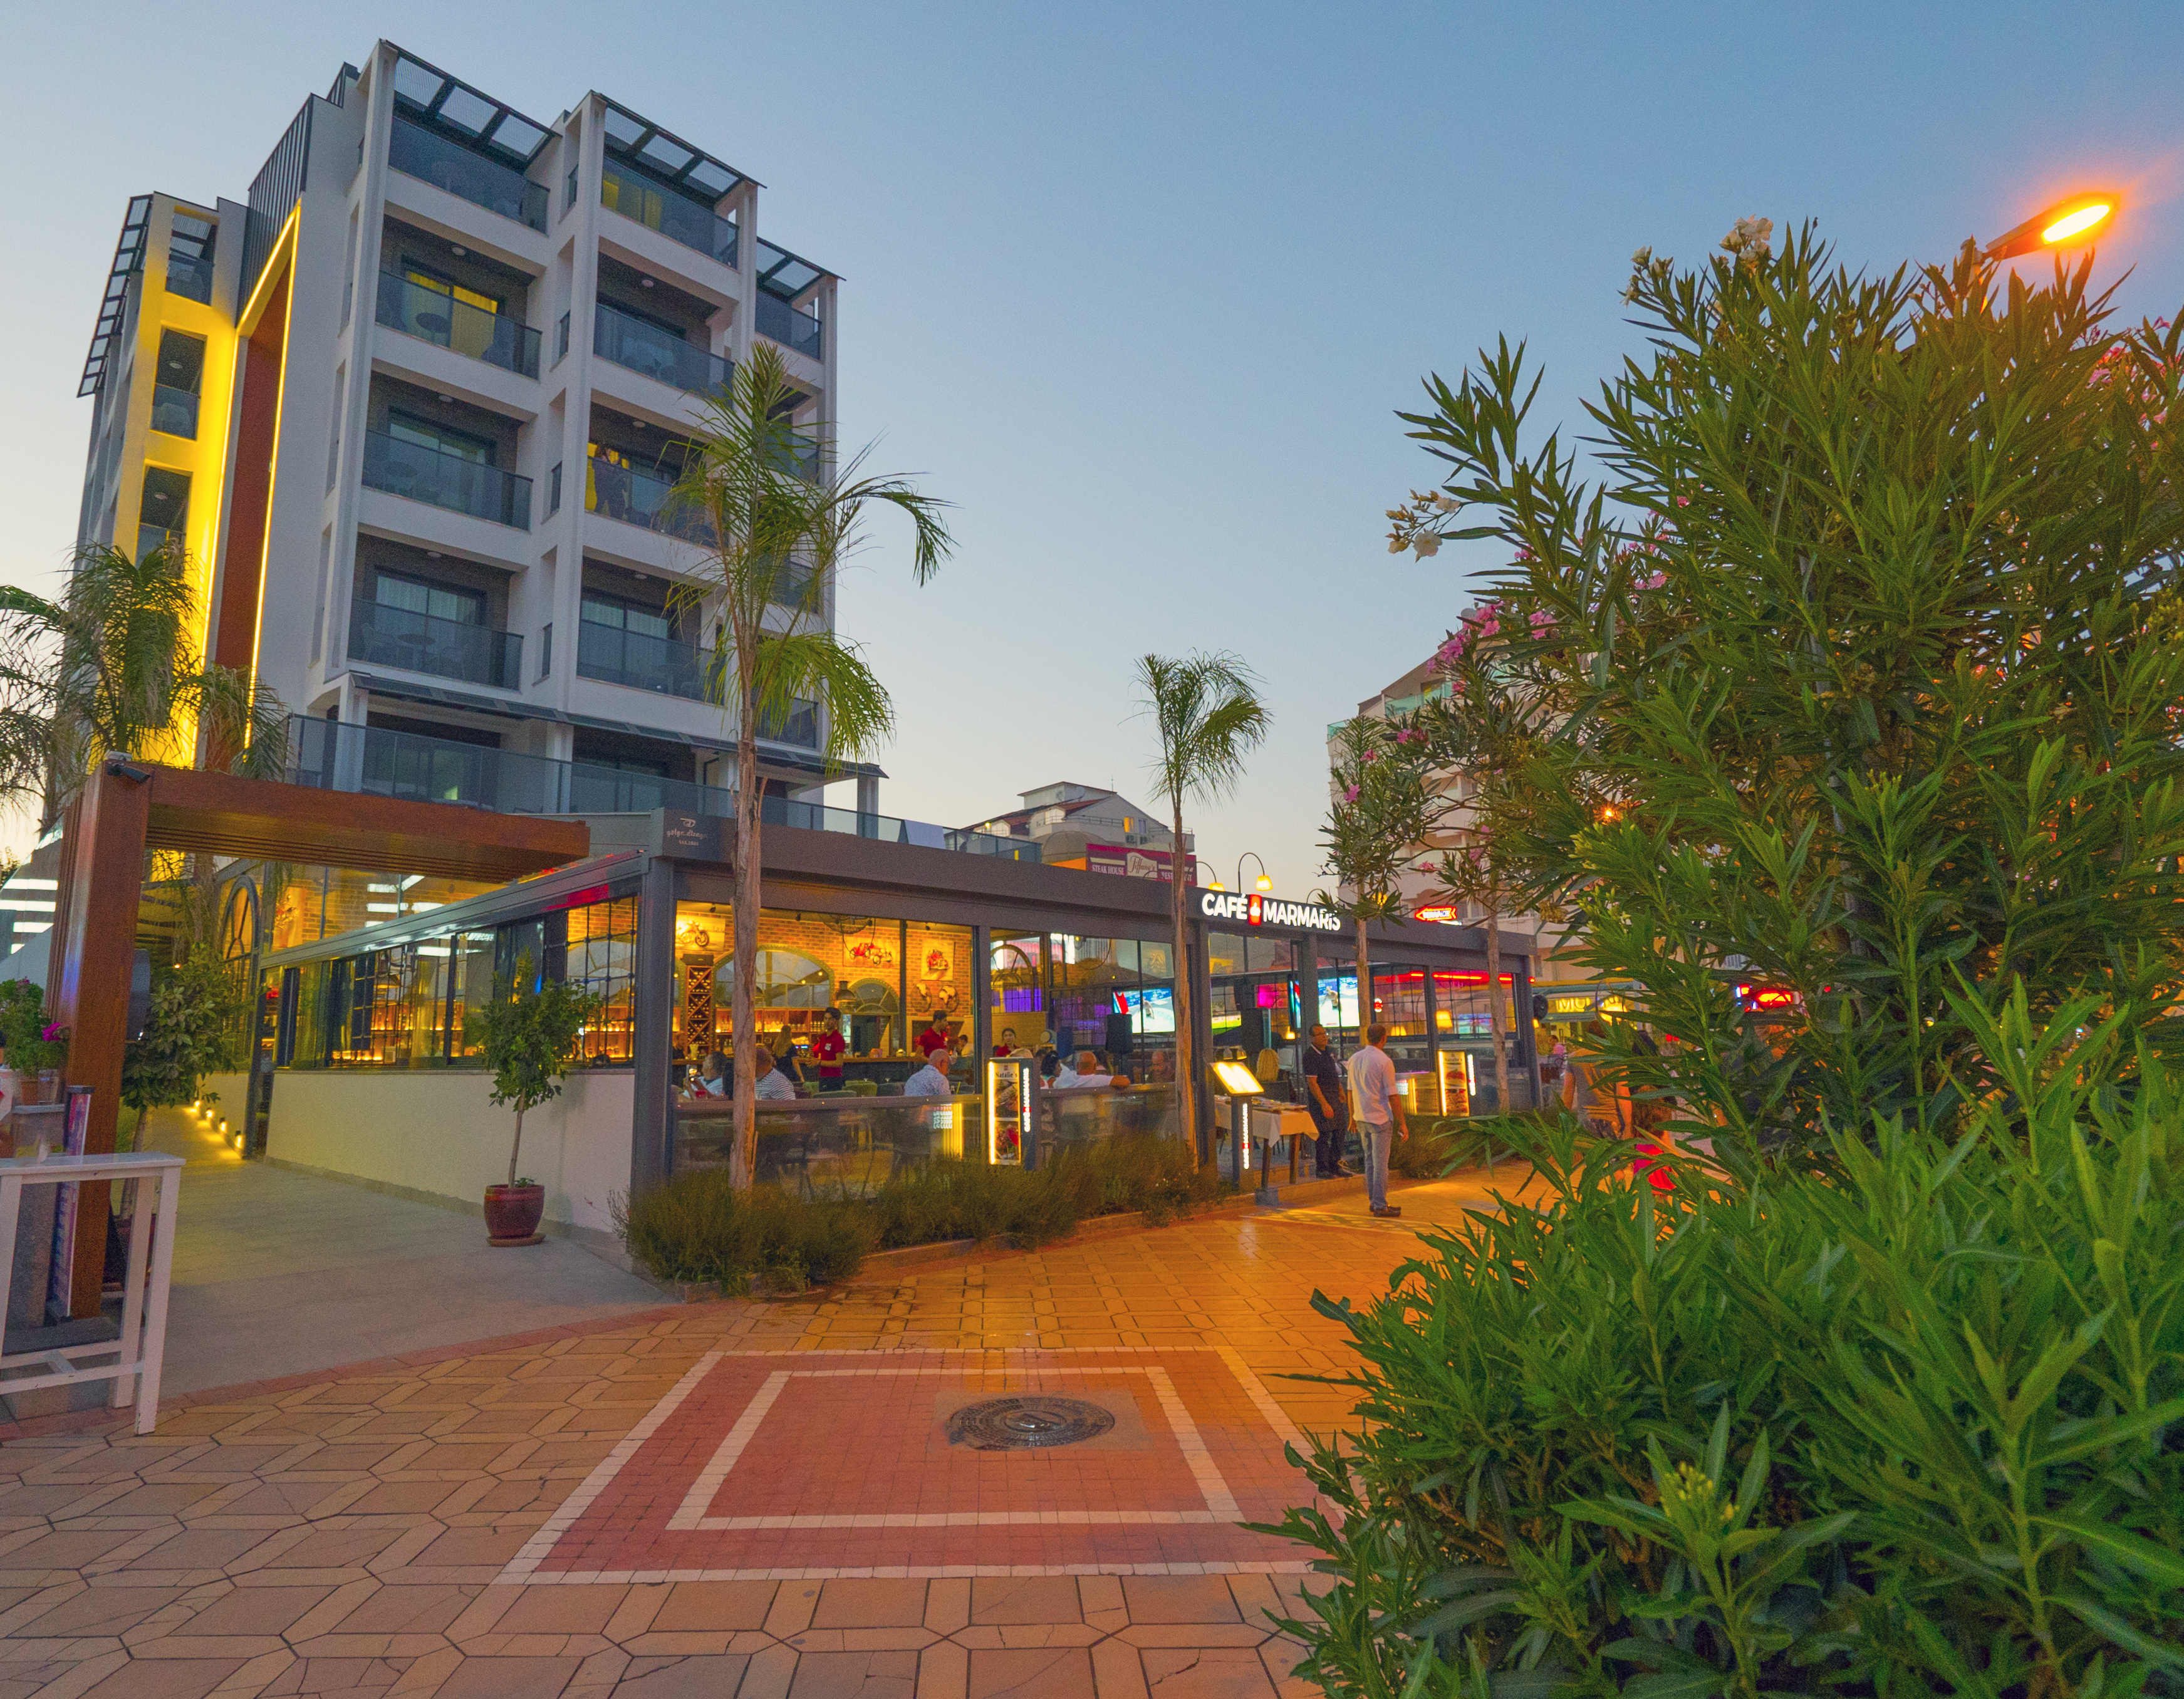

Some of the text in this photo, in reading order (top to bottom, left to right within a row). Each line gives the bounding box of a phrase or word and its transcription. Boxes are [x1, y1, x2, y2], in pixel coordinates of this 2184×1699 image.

[1091, 865, 1125, 875] STEAK HOUSE
[1128, 855, 1155, 873] Tiffany's
[1202, 893, 1248, 920] CAFÉ
[1263, 900, 1341, 931] MARMARIS
